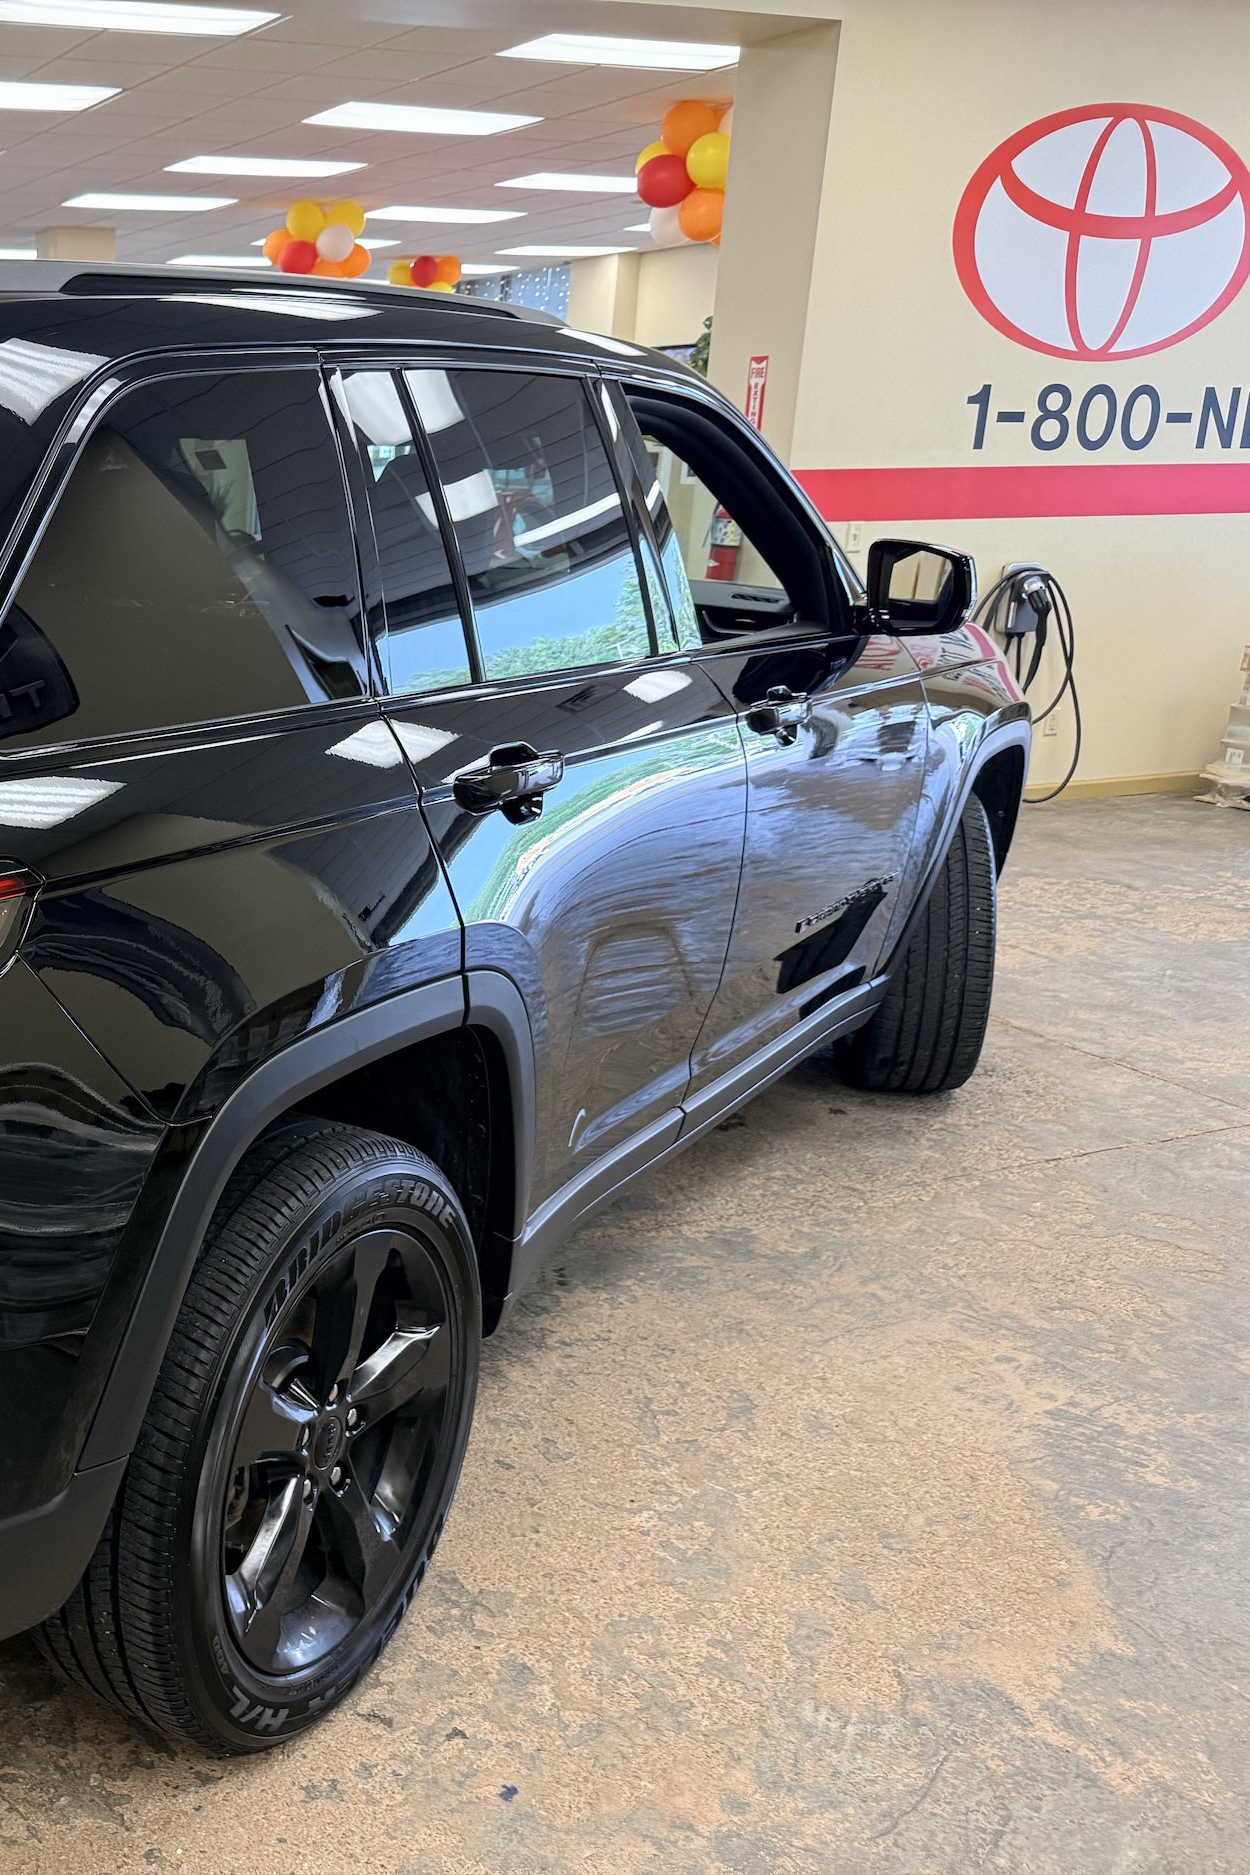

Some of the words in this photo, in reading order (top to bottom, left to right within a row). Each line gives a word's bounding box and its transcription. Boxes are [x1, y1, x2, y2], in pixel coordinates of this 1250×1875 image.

[751, 367, 765, 378] FIRE
[750, 382, 760, 425] EXTING
[966, 383, 1250, 451] 1-800-N
[263, 1178, 457, 1330] BRIDGESTONE
[229, 1685, 290, 1732] H/L
